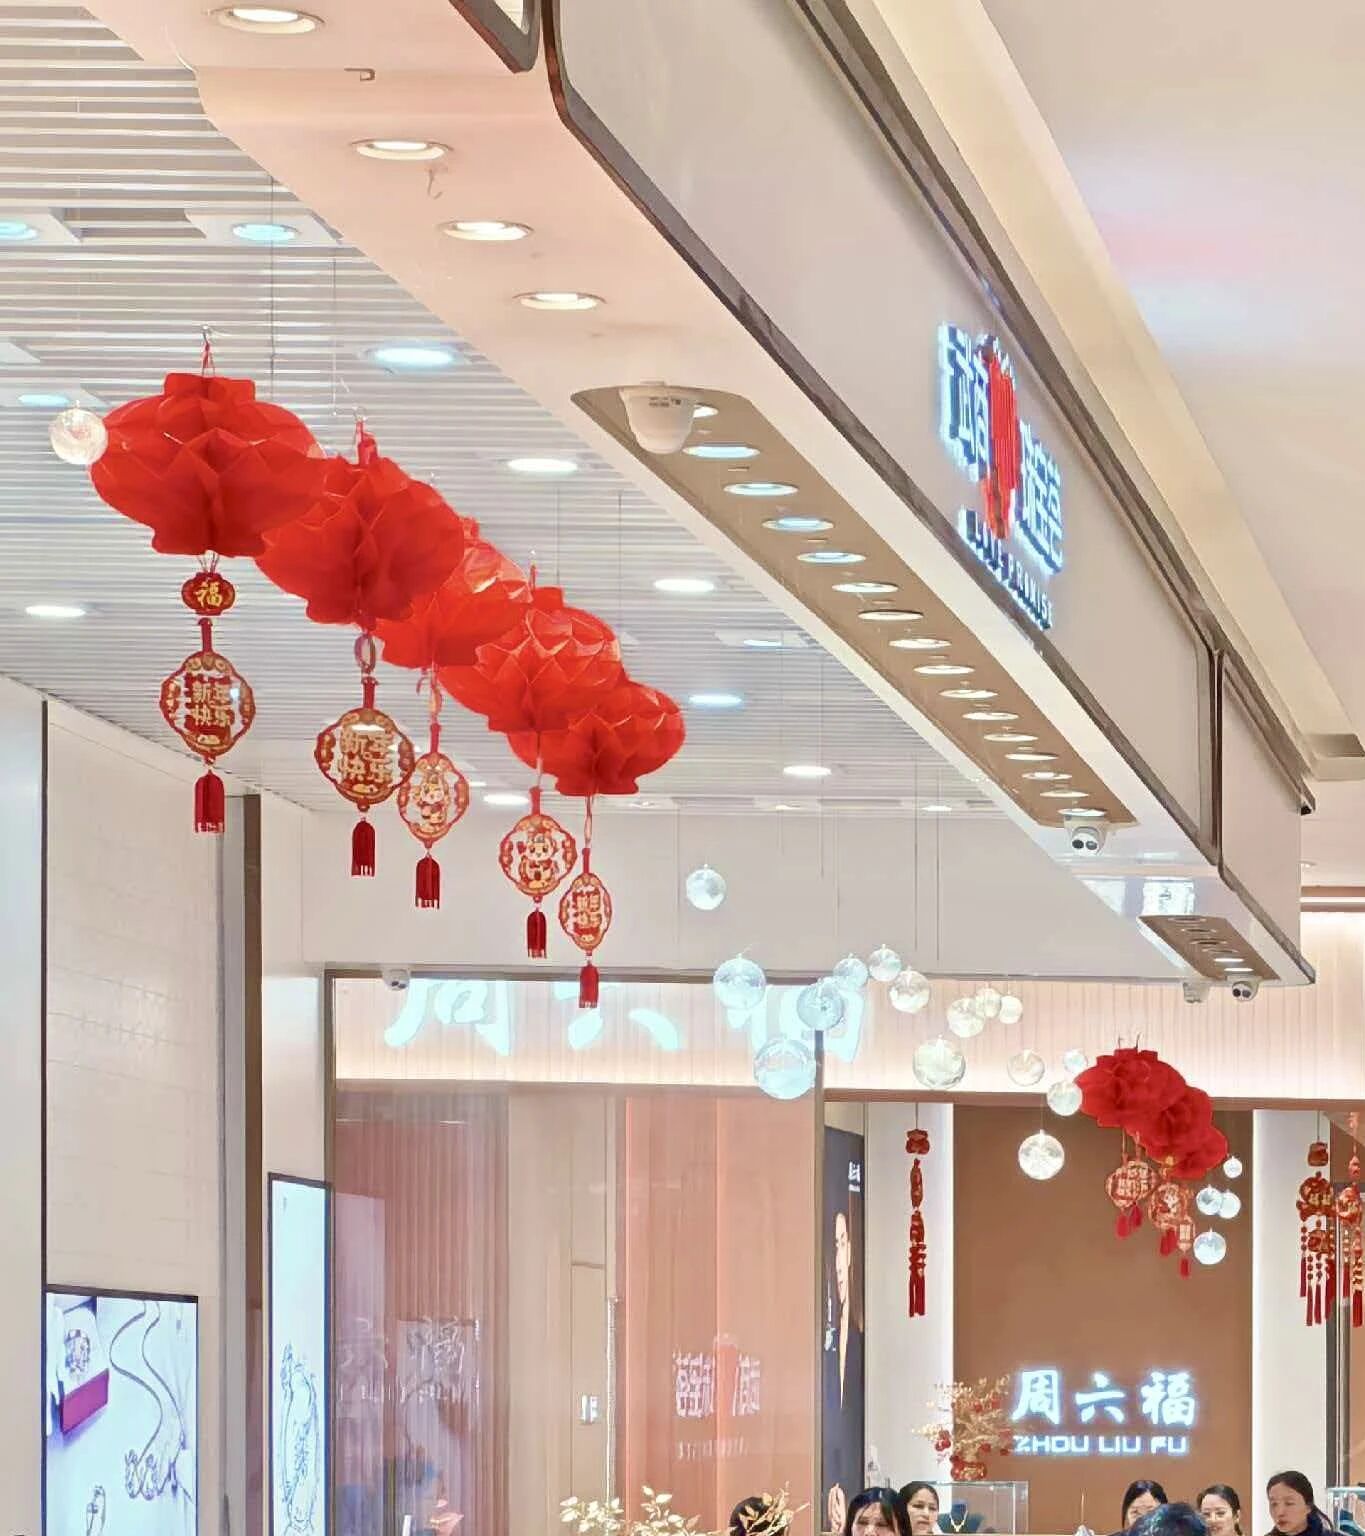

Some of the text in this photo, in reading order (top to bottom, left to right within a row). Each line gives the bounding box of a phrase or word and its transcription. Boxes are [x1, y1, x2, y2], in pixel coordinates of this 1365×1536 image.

[195, 581, 222, 607] 福
[1011, 1369, 1196, 1427] 周六福
[1013, 1435, 1187, 1454] ZHOU LIU FU
